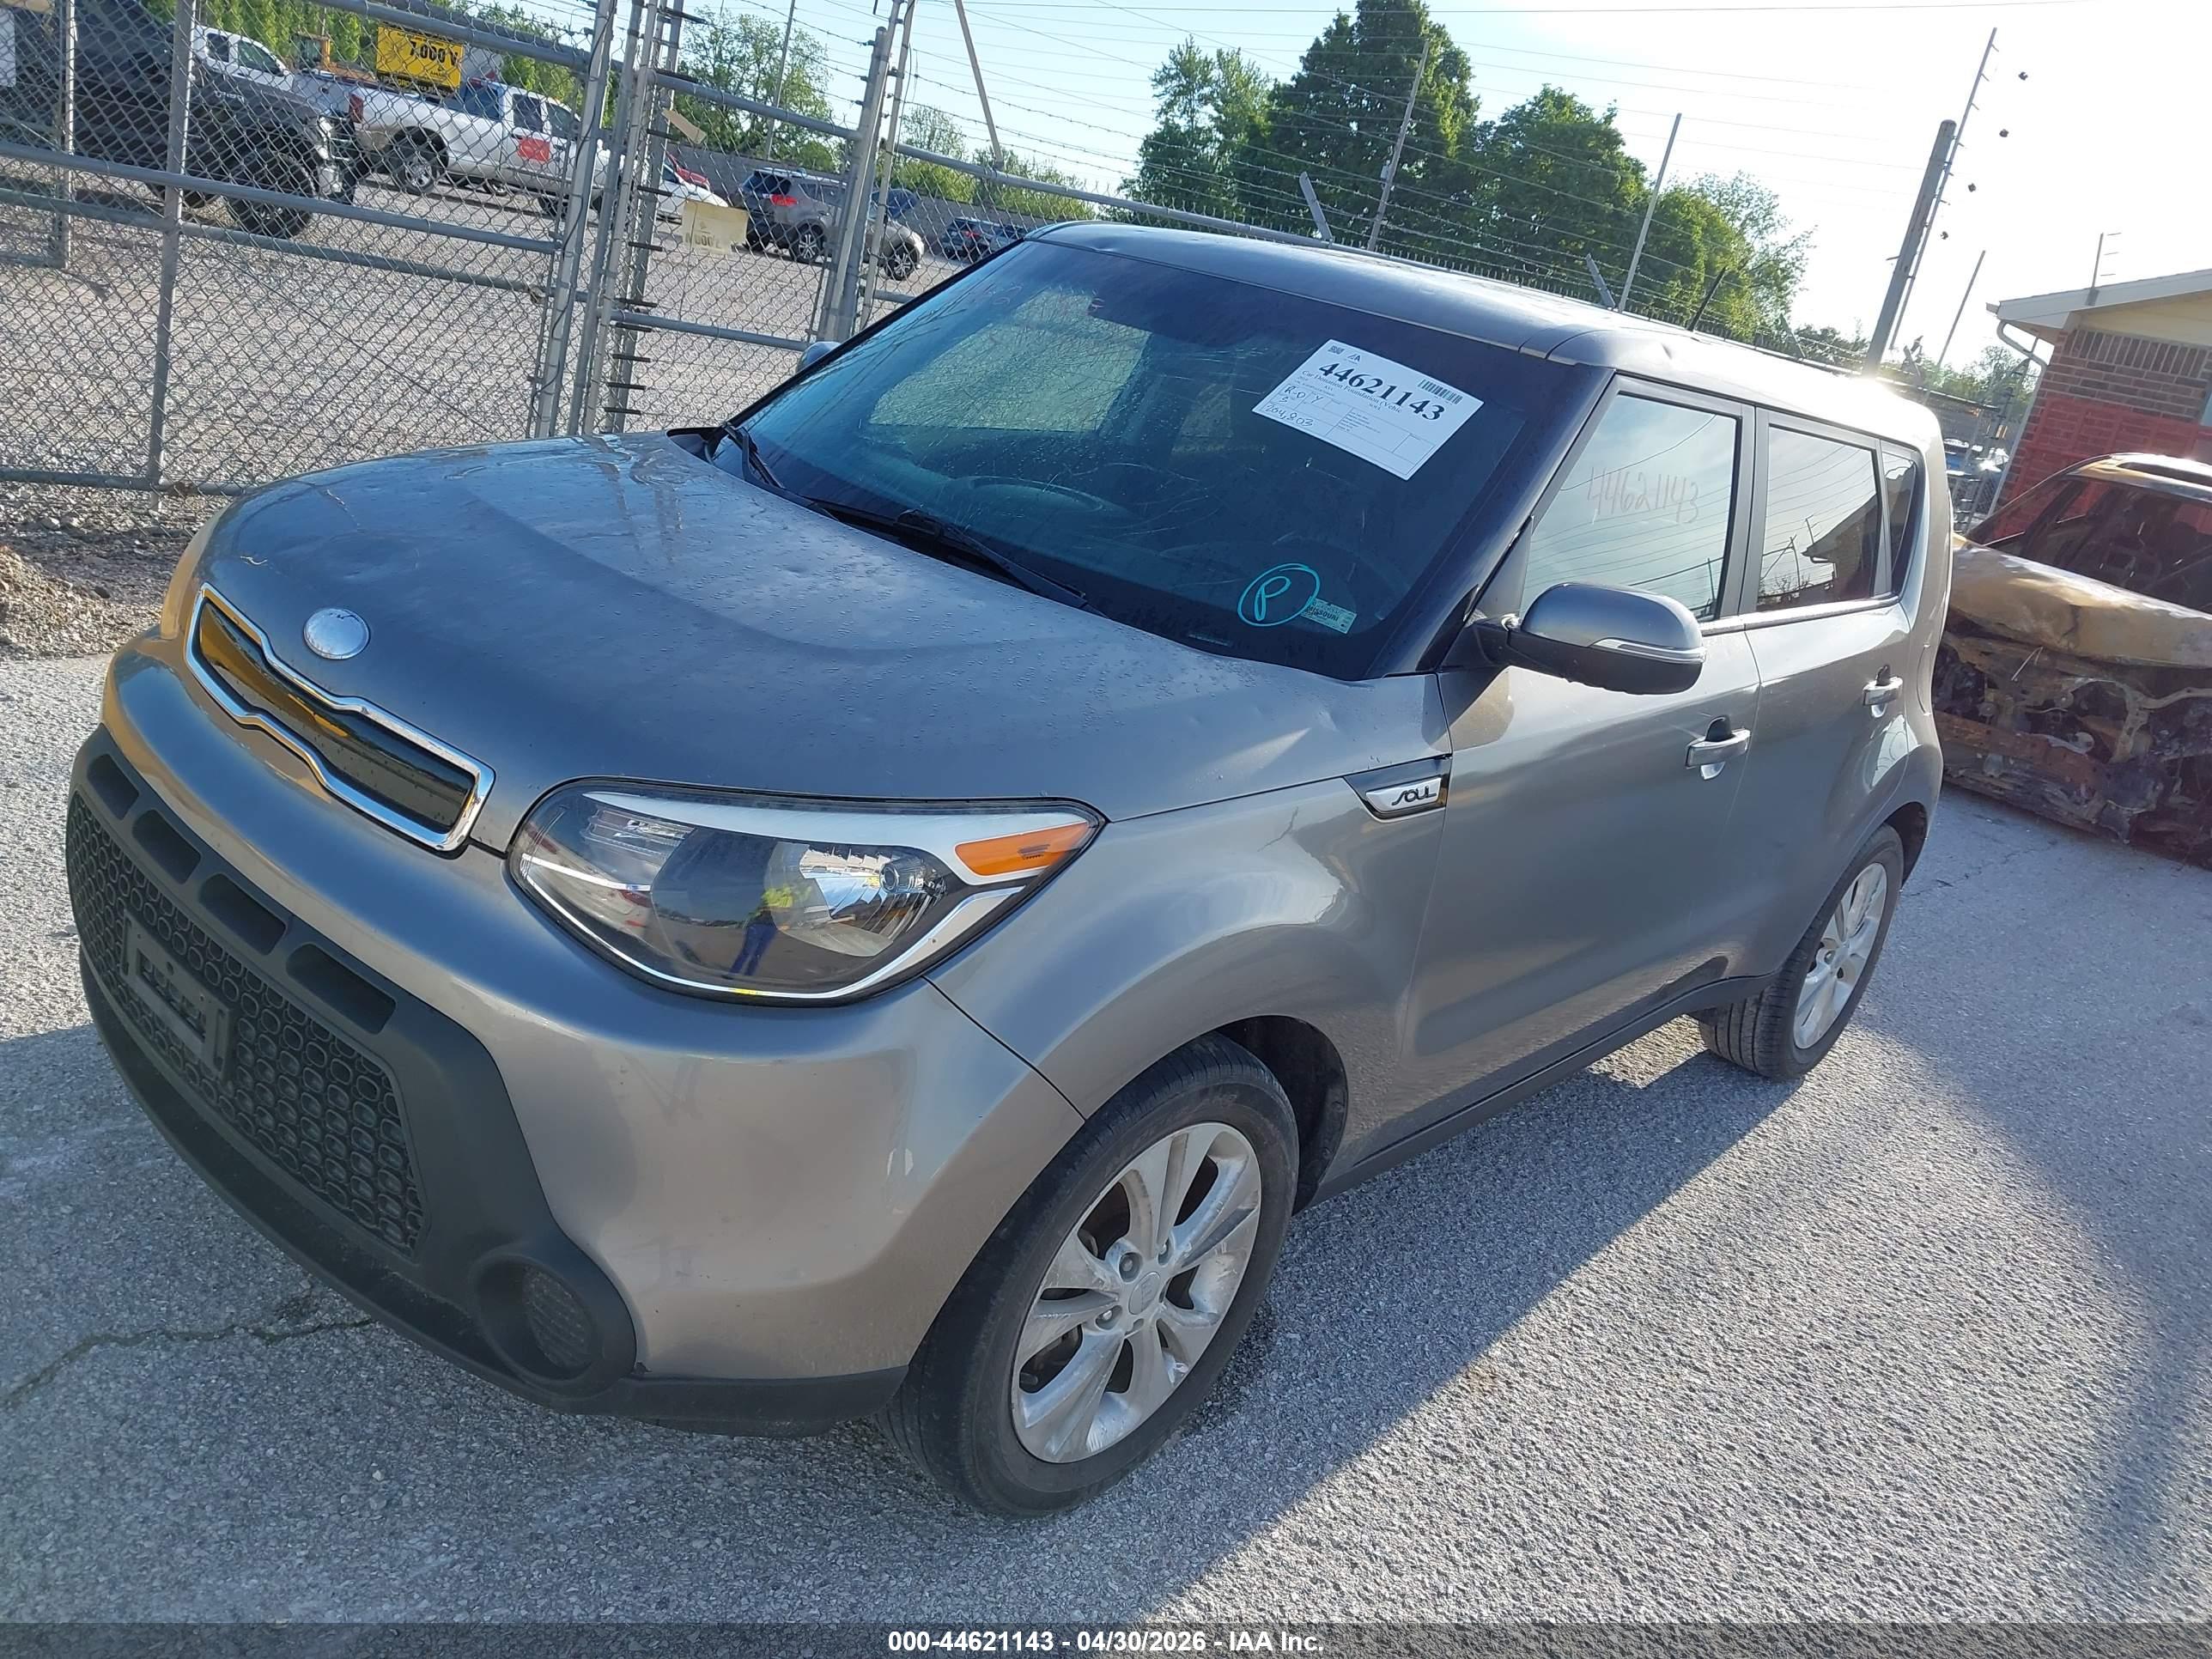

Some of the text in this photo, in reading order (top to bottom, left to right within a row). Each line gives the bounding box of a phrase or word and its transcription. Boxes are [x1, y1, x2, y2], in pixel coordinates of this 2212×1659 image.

[1314, 373, 1343, 390] Donation
[1344, 384, 1379, 404] Foundation
[1318, 362, 1445, 421] 44621143
[1587, 466, 1700, 525] 44621143
[1391, 786, 1437, 806] SOUL
